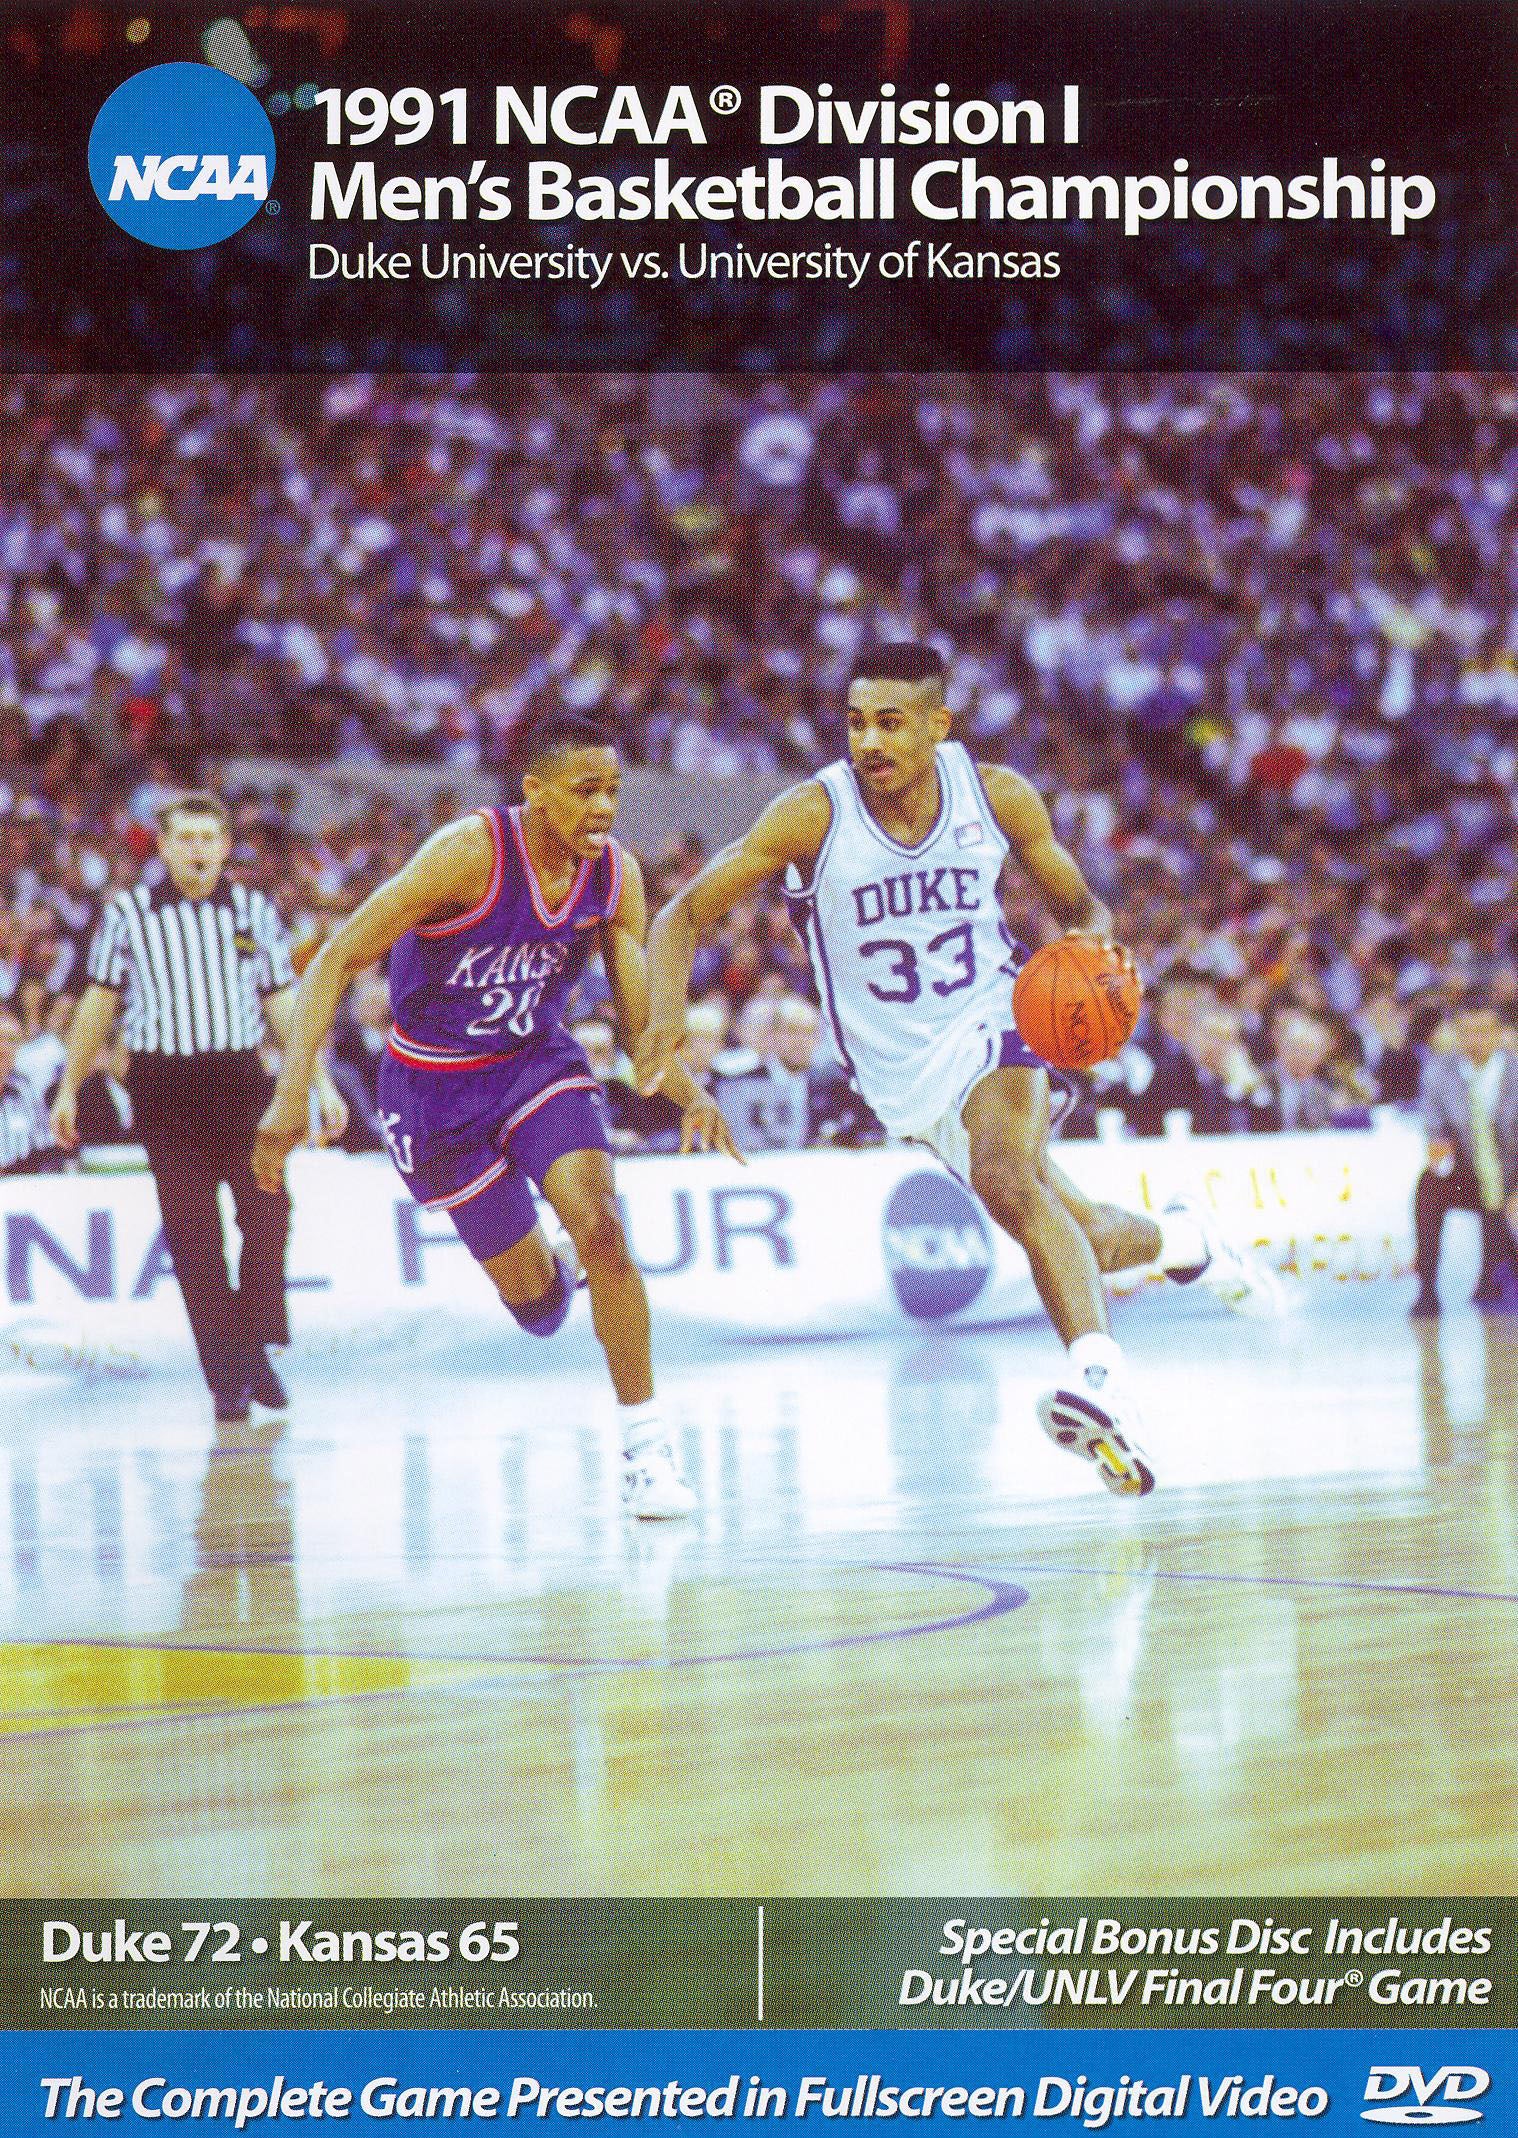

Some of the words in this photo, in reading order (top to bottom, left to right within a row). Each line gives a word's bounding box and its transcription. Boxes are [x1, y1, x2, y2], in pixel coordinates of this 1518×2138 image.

[852, 867, 981, 928] DUKE
[859, 922, 979, 1005] 33
[392, 1187, 797, 1286] FUR
